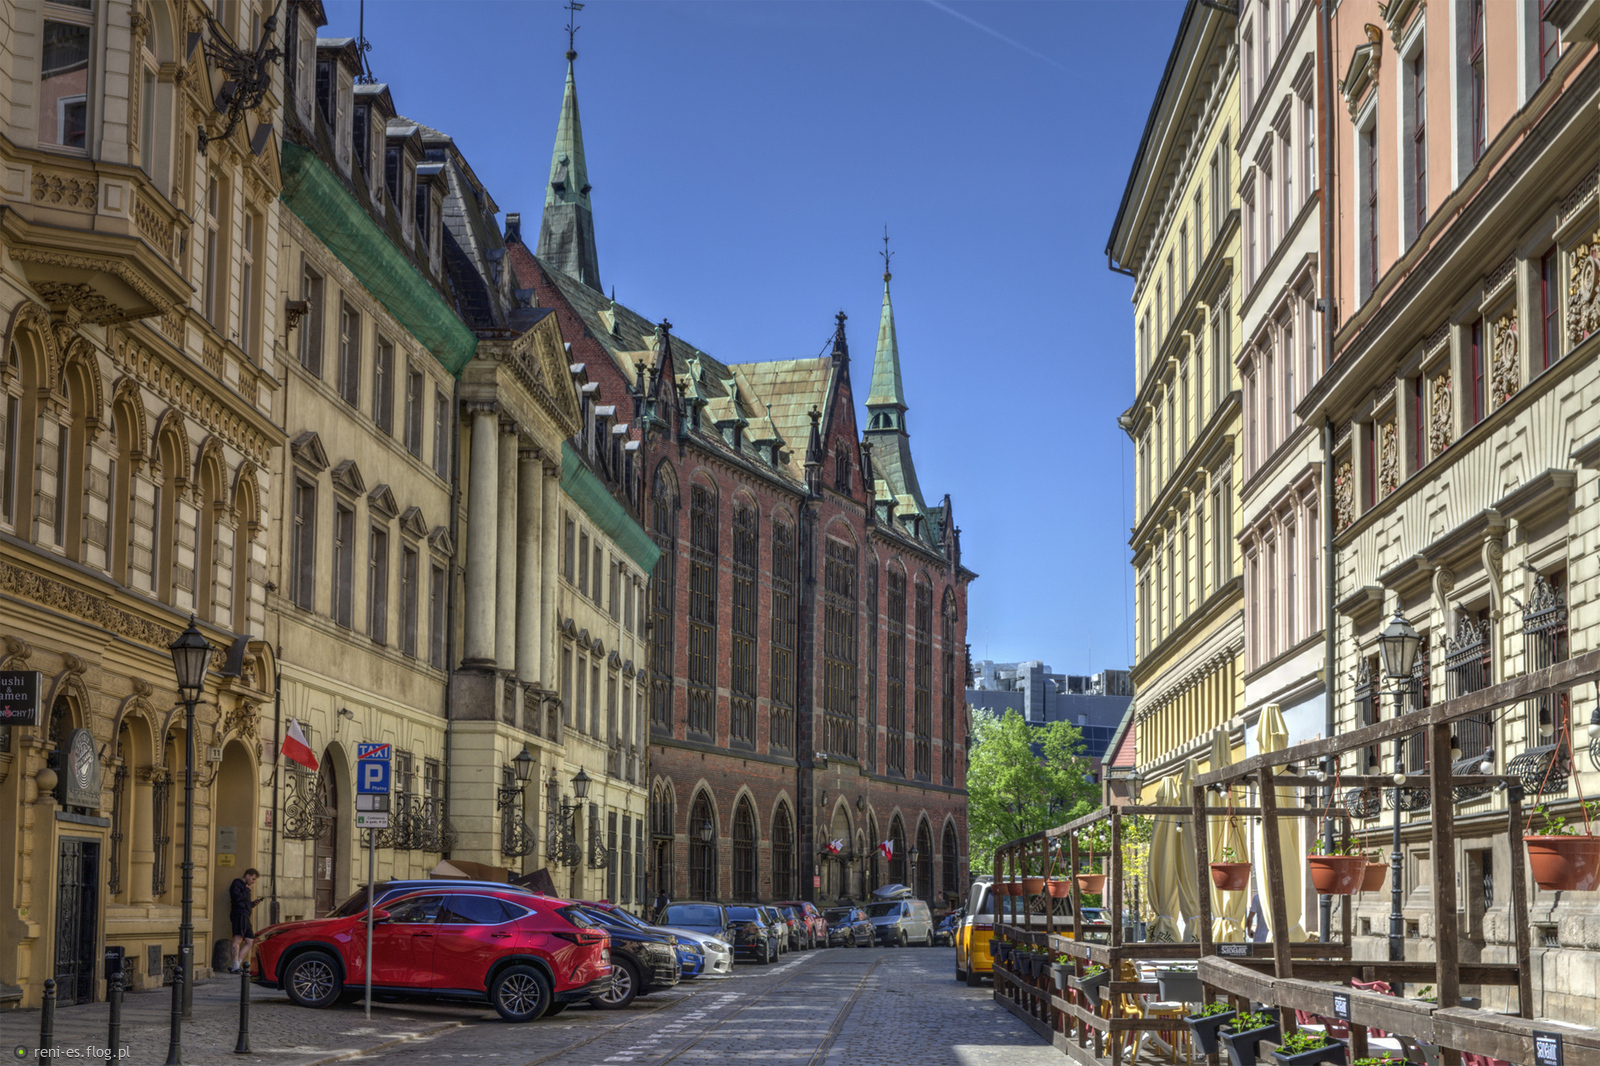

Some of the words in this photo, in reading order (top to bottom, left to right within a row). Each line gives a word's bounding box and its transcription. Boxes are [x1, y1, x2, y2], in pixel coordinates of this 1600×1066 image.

[0, 676, 25, 686] ushi
[213, 749, 220, 757] 11
[359, 745, 388, 758] TAXI
[364, 763, 383, 790] P
